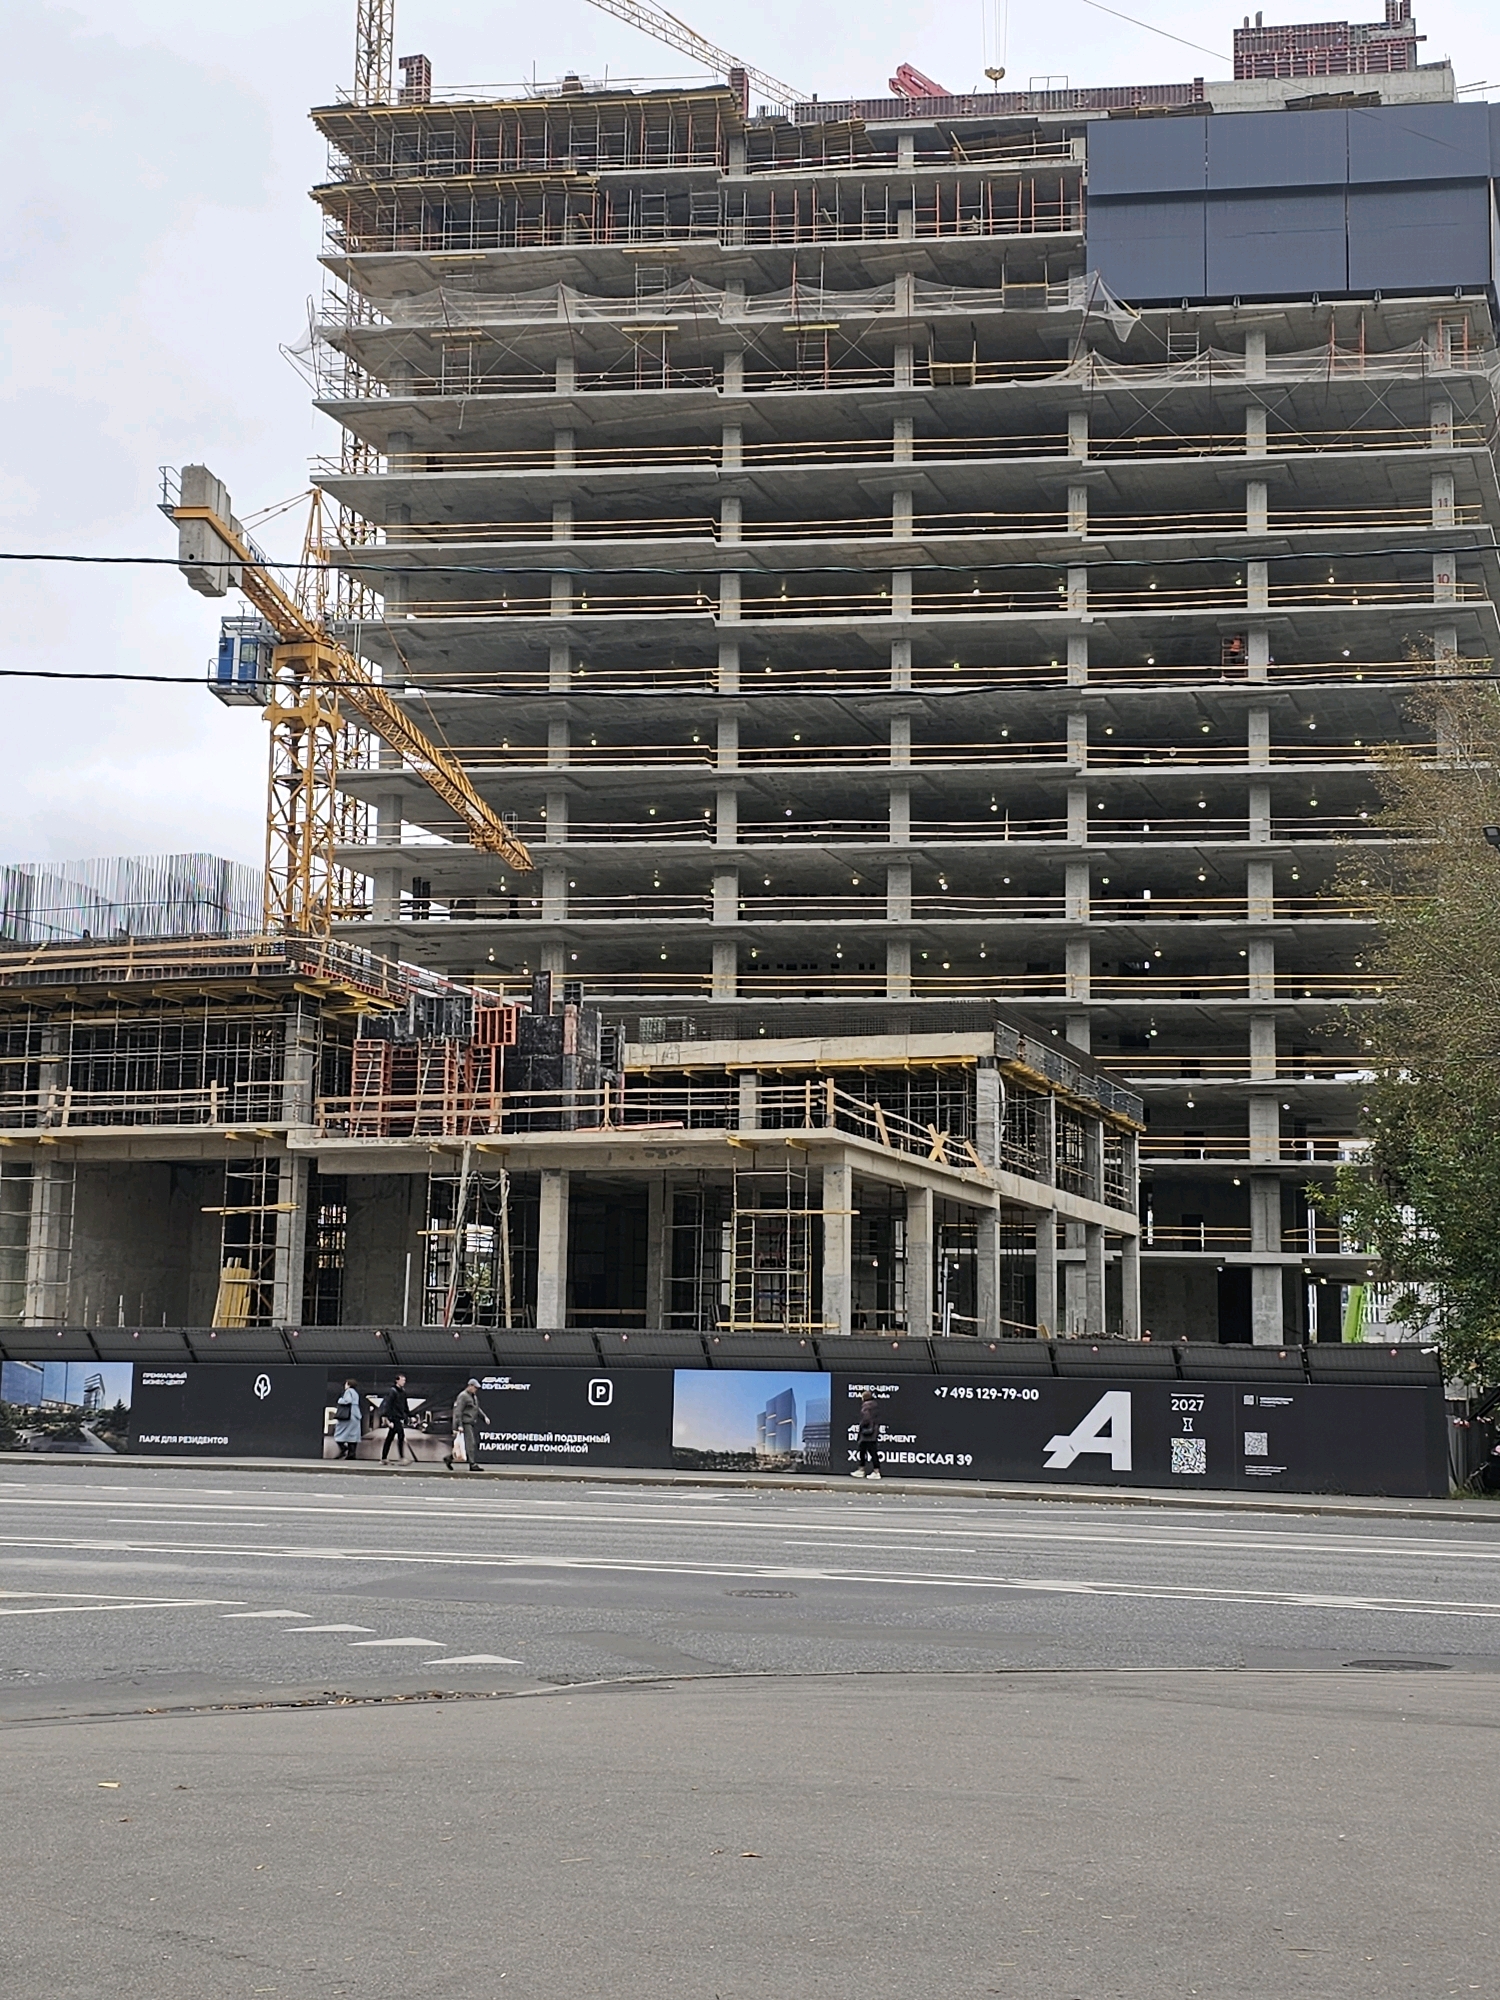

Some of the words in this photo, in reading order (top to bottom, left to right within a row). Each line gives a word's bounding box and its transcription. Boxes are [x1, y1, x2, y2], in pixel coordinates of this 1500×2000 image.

[1432, 422, 1449, 435] 12
[1436, 573, 1450, 584] 10
[848, 1384, 899, 1392] БИЗНЕС-ЦЕНТР
[934, 1387, 948, 1398] +7
[950, 1387, 973, 1398] 495
[976, 1388, 1039, 1400] 129-79-00
[1172, 1399, 1204, 1411] 2027
[161, 1436, 177, 1444] ДЛЯ
[178, 1436, 228, 1444] РЕЗИДЕНТОВ
[480, 1432, 553, 1441] ТРЕХУРОВНЕВЫЙ
[555, 1433, 610, 1444] ПОДЗЕМНЫЙ
[479, 1443, 519, 1451] ПАРКИНГ
[528, 1443, 588, 1453] АВТОМОЙКОЙ
[957, 1454, 972, 1465] 39
